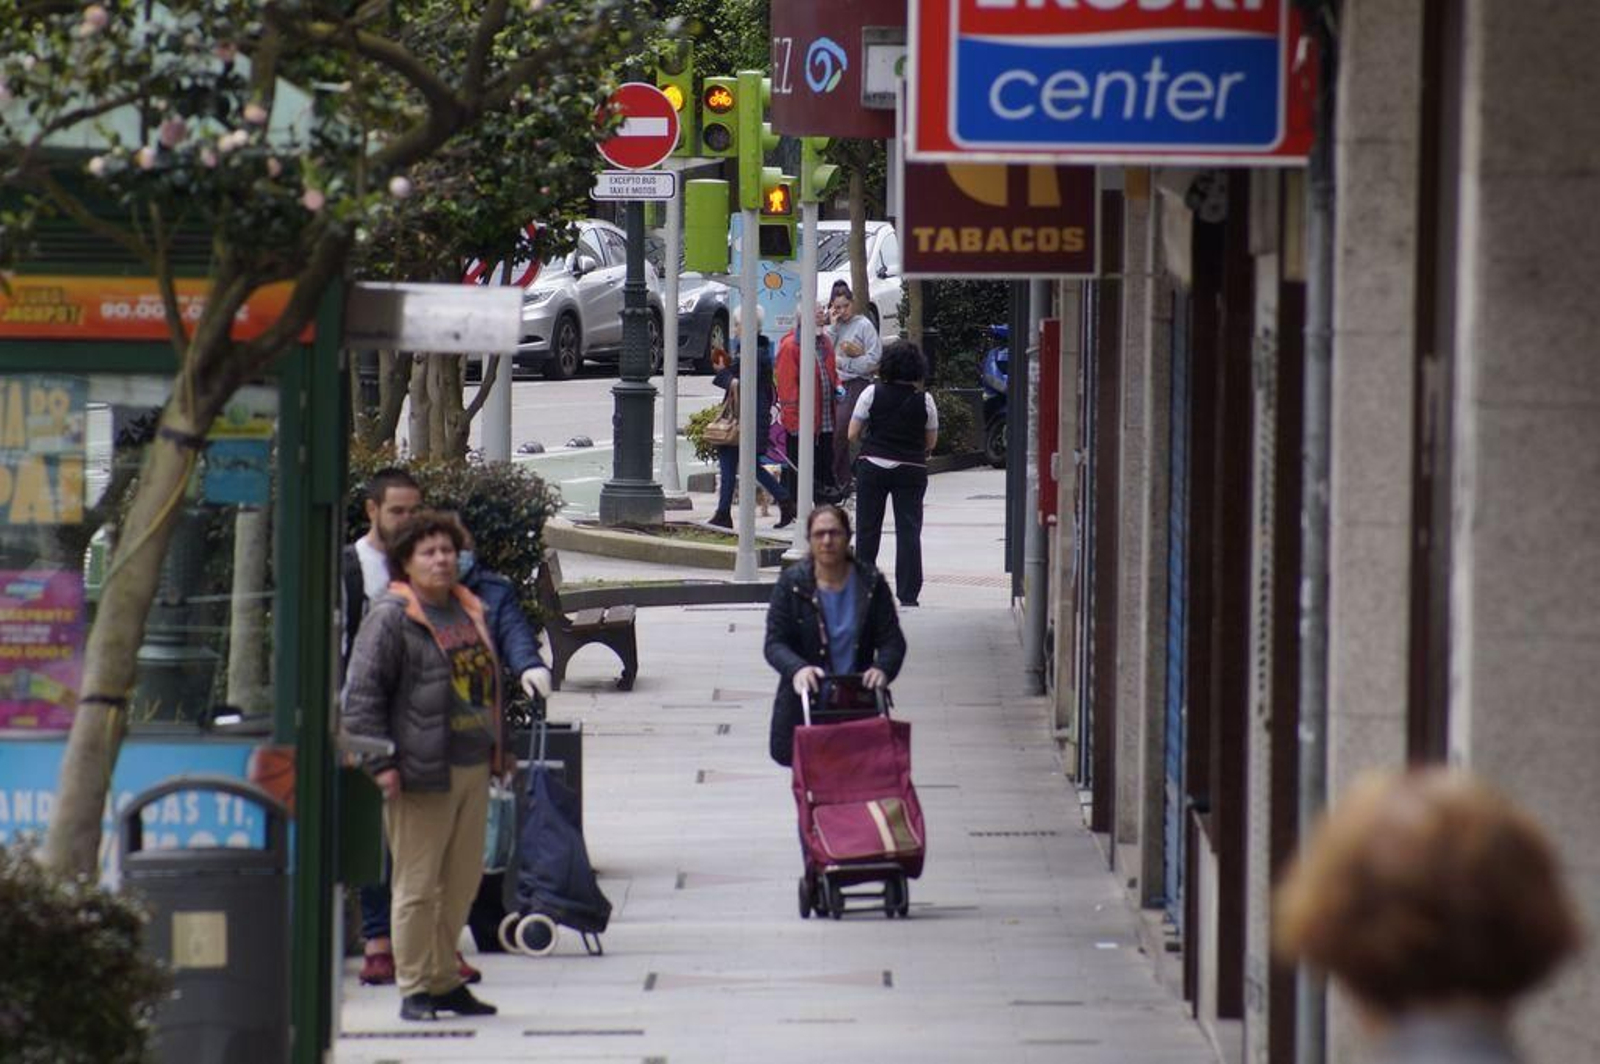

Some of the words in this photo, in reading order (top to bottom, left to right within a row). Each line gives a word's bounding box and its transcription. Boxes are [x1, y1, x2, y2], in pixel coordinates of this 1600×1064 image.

[988, 56, 1245, 121] center
[609, 176, 641, 185] EXCEPTO
[642, 176, 657, 185] BUS
[610, 186, 624, 194] TAXI
[912, 227, 1085, 252] TABACOS
